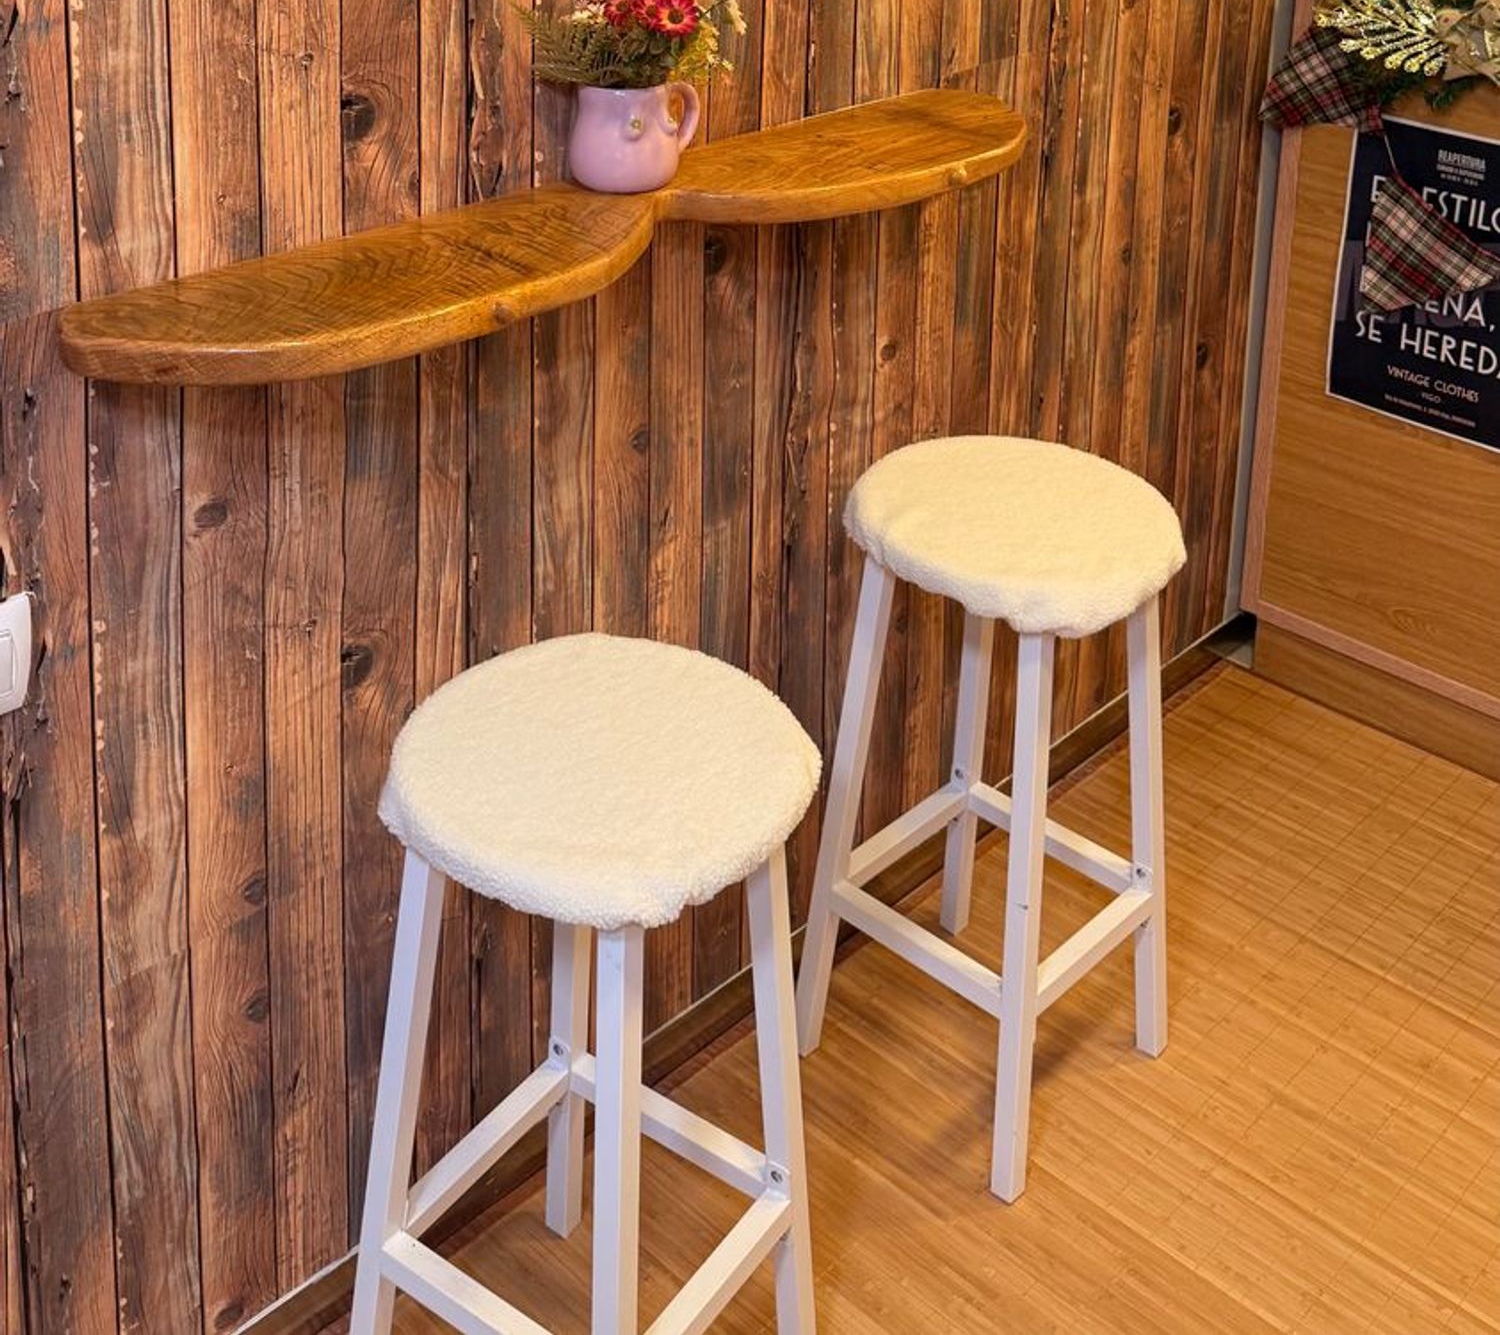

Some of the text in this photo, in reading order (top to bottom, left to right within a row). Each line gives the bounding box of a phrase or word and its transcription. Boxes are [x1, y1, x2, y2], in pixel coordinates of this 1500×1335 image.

[1355, 310, 1500, 379] SE HERED
[1387, 364, 1480, 403] VINTAGE CLOTHES
